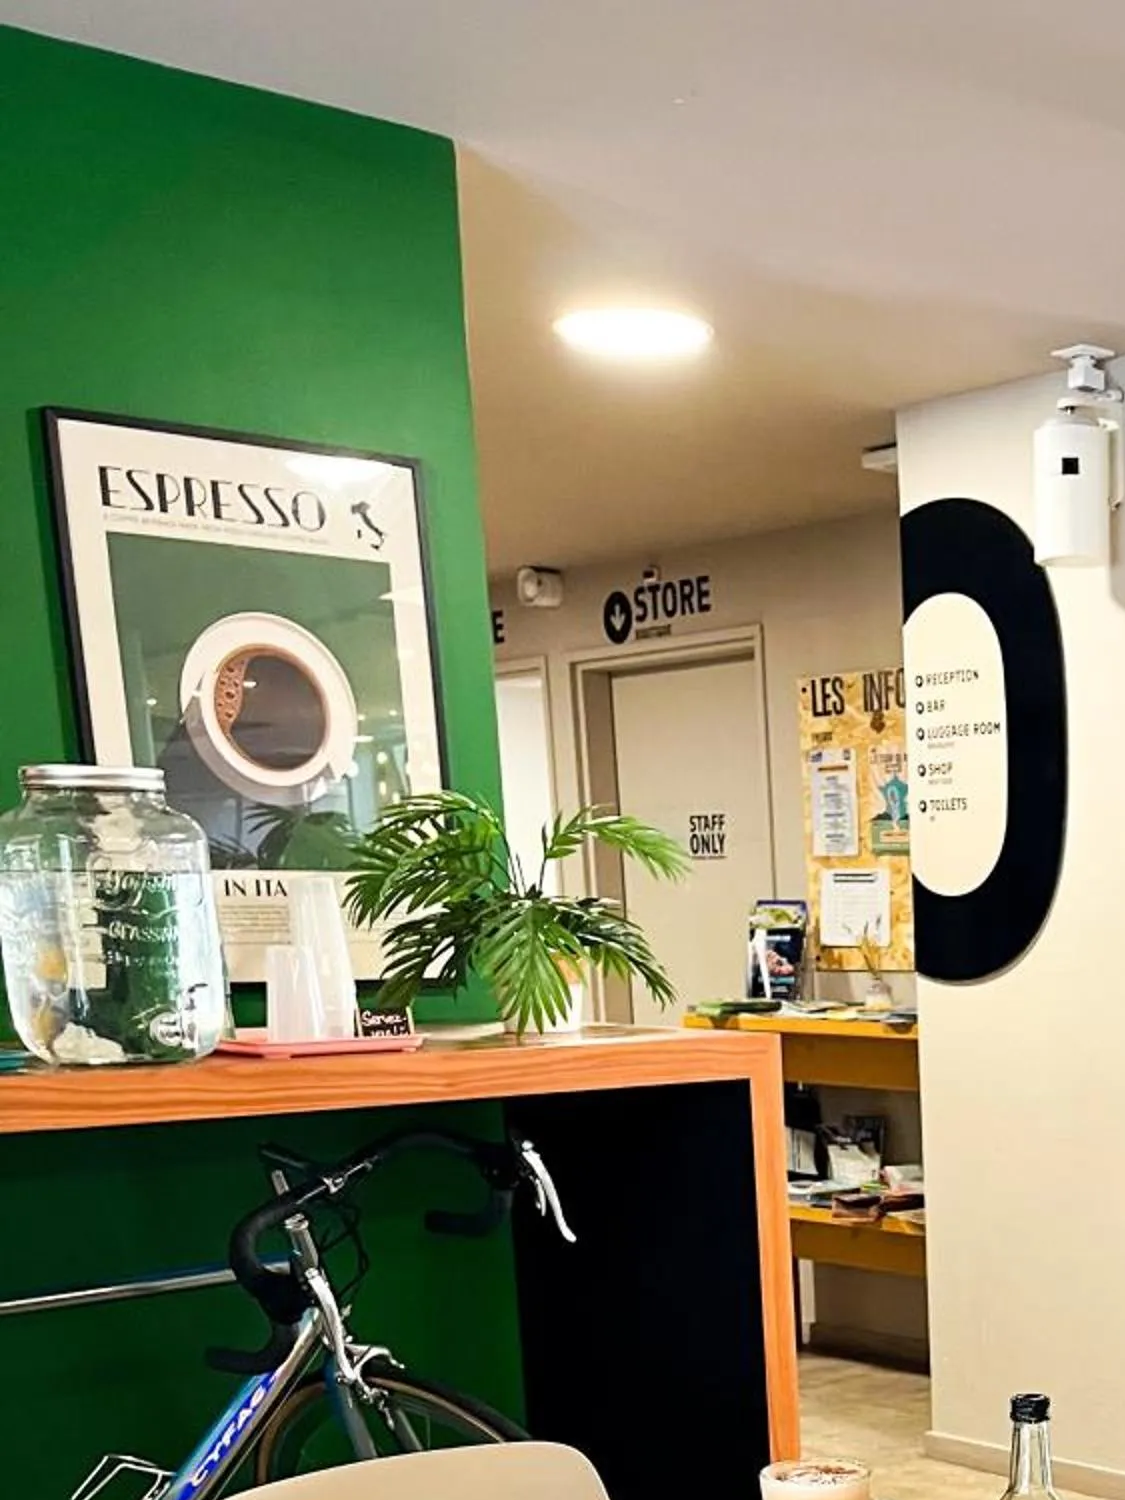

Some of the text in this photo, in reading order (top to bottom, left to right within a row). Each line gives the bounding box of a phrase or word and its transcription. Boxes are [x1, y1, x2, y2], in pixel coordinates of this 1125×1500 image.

[98, 465, 326, 532] ESPRESSO
[634, 575, 712, 623] STORE
[926, 669, 979, 686] RECEPTION
[811, 676, 846, 717] LES
[926, 699, 945, 713] BAR
[927, 721, 1001, 740] LUGGAGE ROOM
[928, 762, 953, 776] SHOP
[929, 797, 968, 811] TOILETS
[689, 814, 726, 832] STAFF
[689, 833, 726, 854] ONLY
[224, 879, 288, 896] IN ITA
